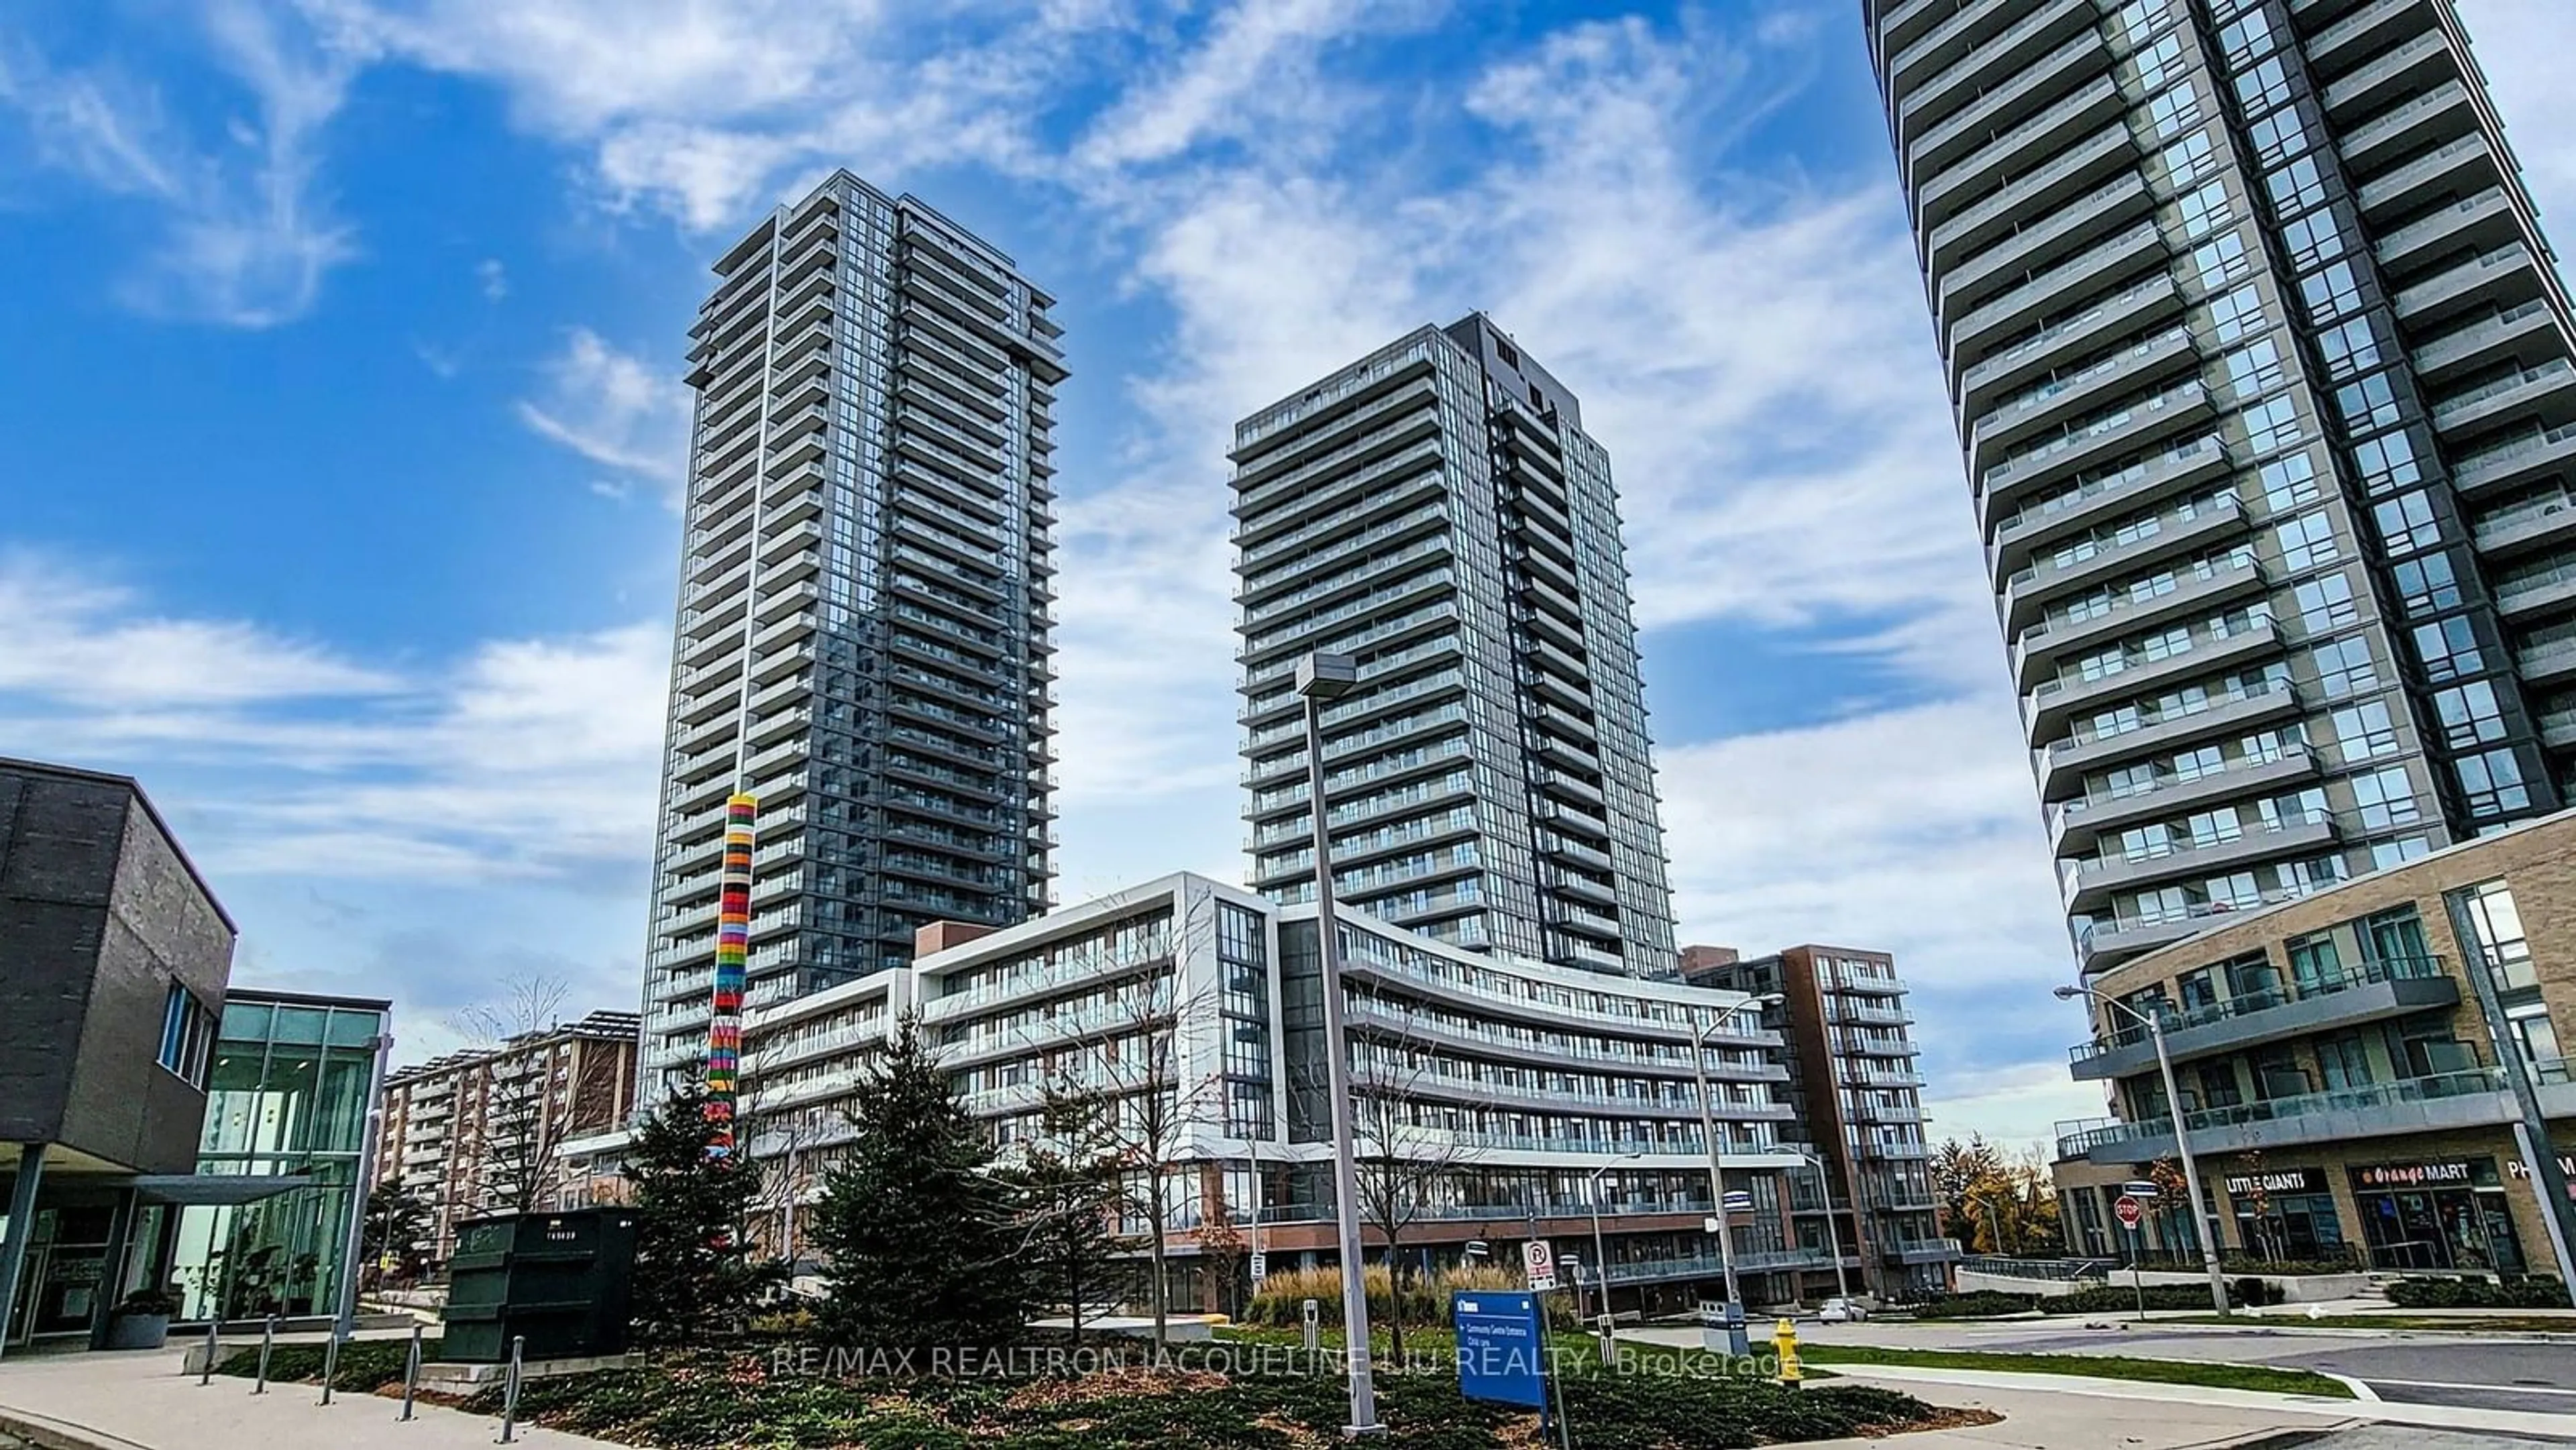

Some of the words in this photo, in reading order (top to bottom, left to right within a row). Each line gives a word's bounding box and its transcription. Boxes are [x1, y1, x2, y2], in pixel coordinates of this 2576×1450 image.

[2225, 1176, 2262, 1193] LITTLE
[2262, 1172, 2305, 1191] GIANTS
[2375, 1166, 2424, 1186] Orange
[2424, 1164, 2469, 1181] MART
[2117, 1204, 2139, 1215] STOP
